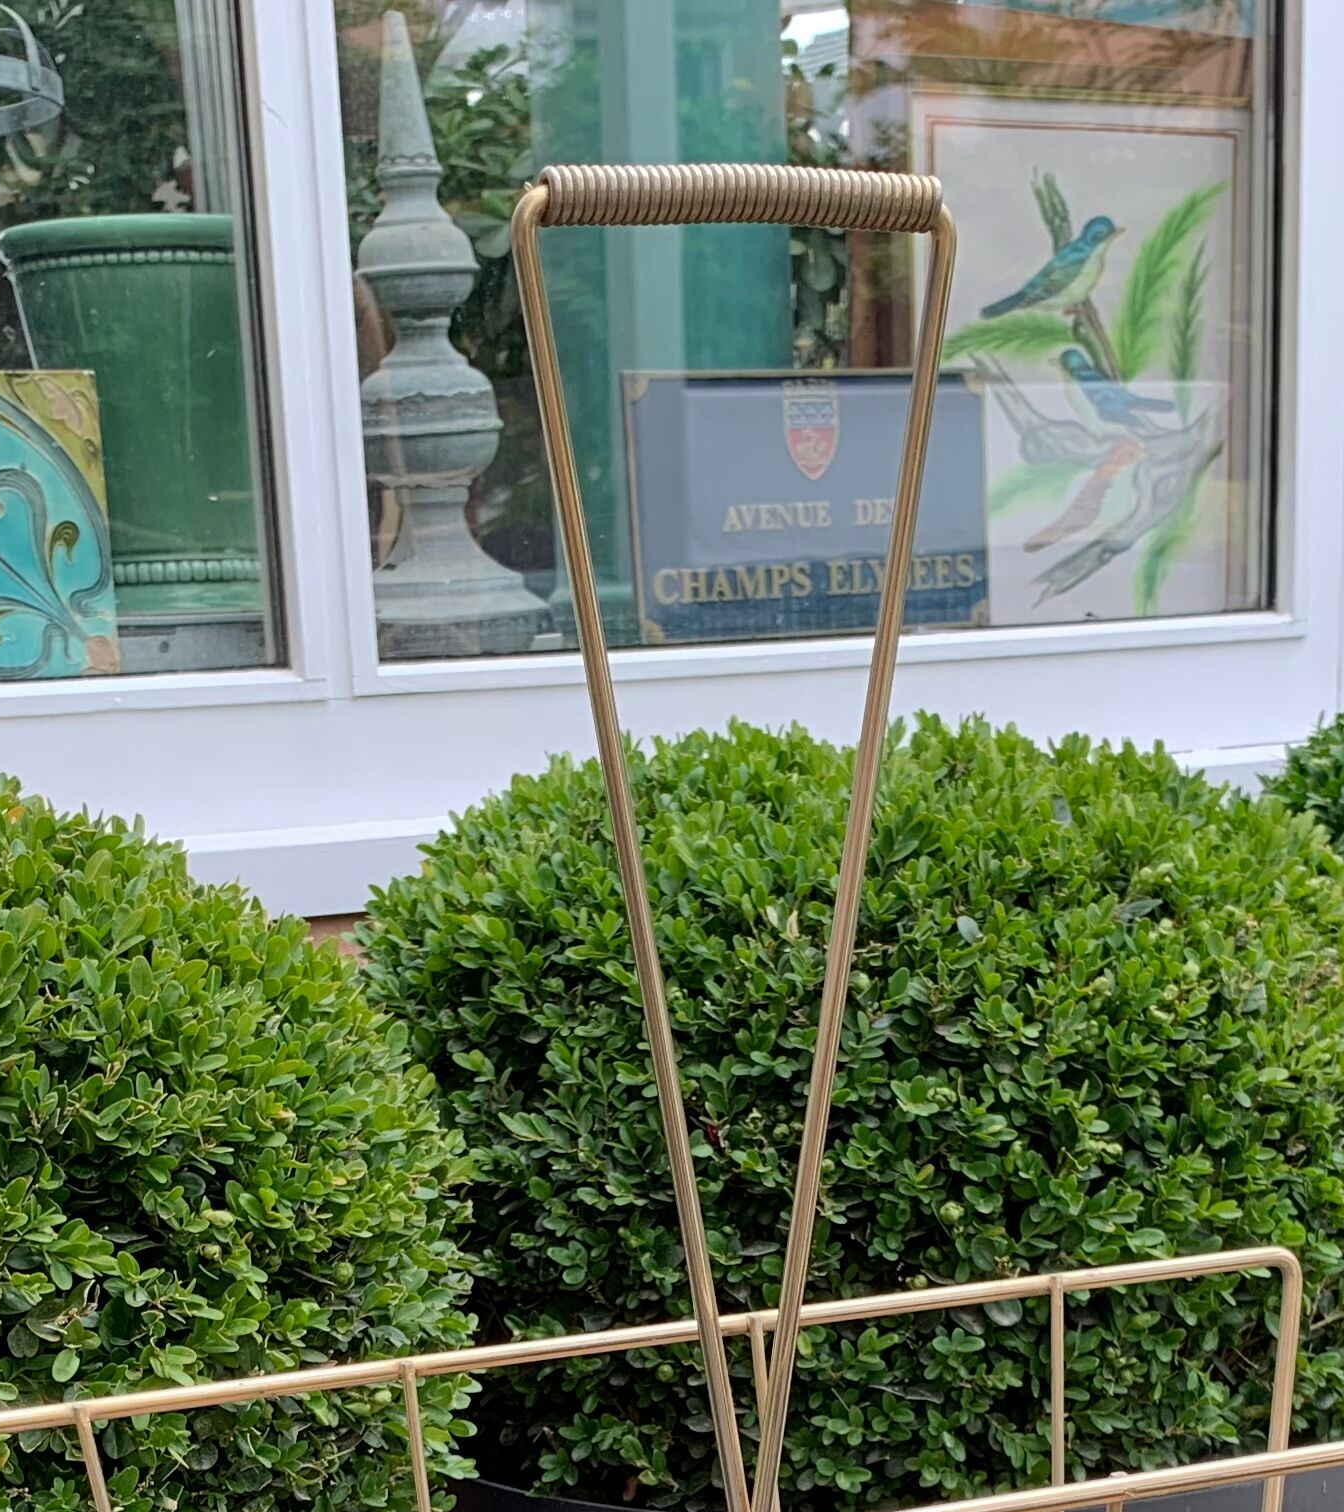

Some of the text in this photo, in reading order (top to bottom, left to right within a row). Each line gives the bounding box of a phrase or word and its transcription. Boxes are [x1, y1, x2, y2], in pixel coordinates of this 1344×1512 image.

[722, 498, 896, 532] AVENUE DE
[655, 563, 812, 604] CHAMPS
